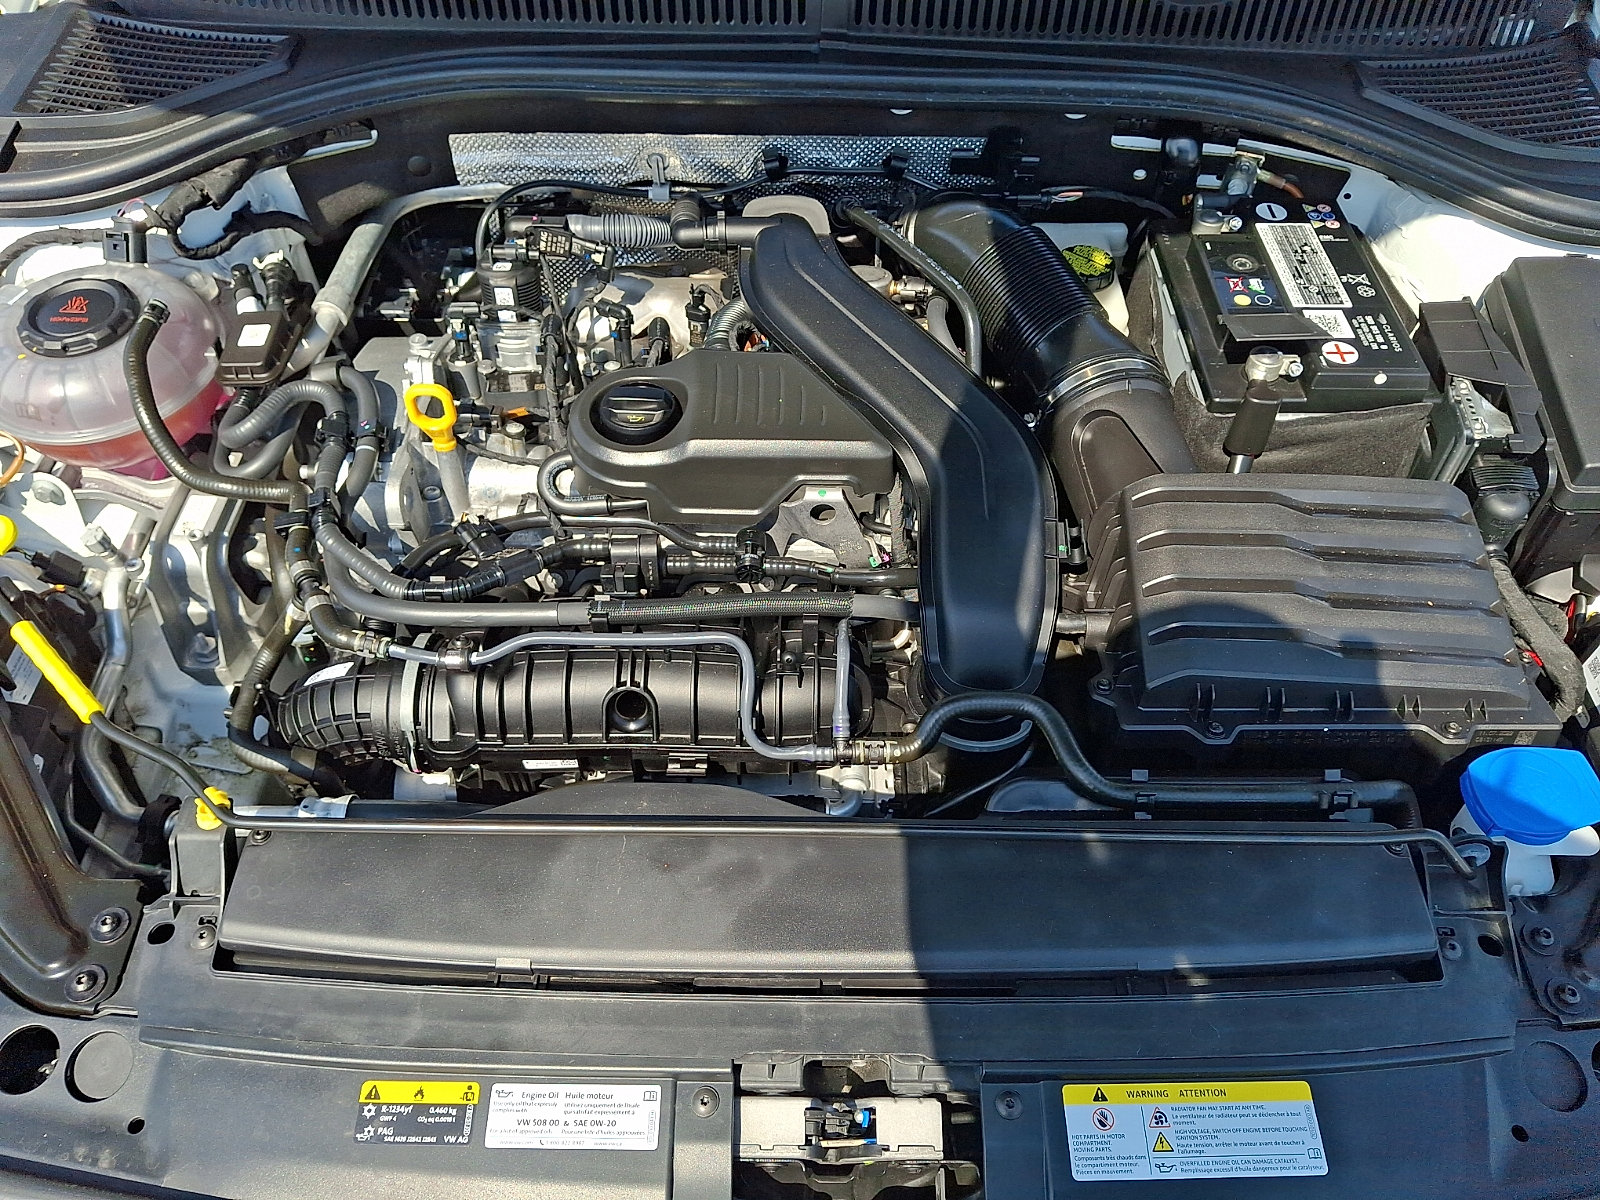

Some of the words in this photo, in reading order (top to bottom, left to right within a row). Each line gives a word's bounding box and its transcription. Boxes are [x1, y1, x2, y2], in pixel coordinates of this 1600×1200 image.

[1382, 324, 1402, 352] CLARIOS
[521, 1092, 547, 1100] Engine
[587, 1092, 614, 1100] moteur
[1126, 1090, 1169, 1098] WARNING
[1179, 1088, 1227, 1098] ATTENTION
[381, 1105, 413, 1115] R-1234yf
[448, 1107, 457, 1116] kg
[377, 1127, 393, 1135] PAG
